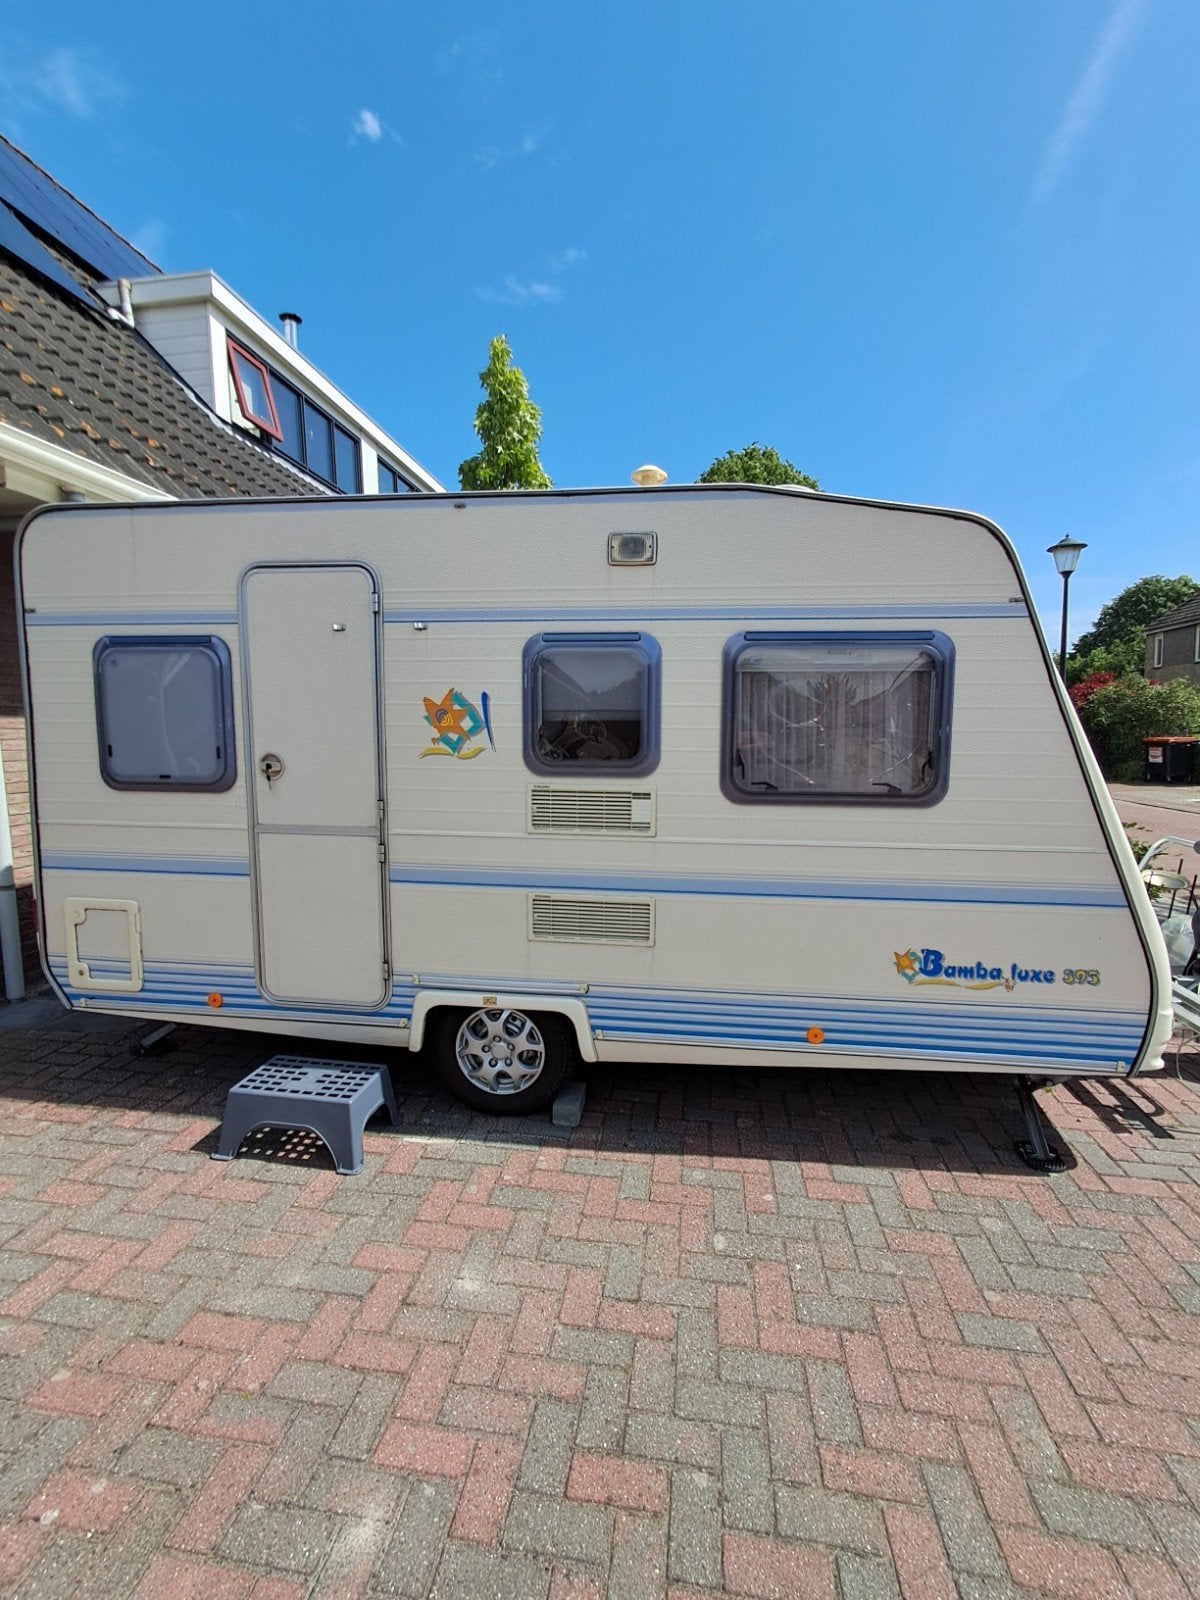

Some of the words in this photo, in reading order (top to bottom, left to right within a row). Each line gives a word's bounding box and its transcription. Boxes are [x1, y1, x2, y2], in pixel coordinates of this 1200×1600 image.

[919, 949, 1002, 981] Bamba
[1011, 963, 1055, 983] luxe
[1062, 968, 1100, 986] 395
